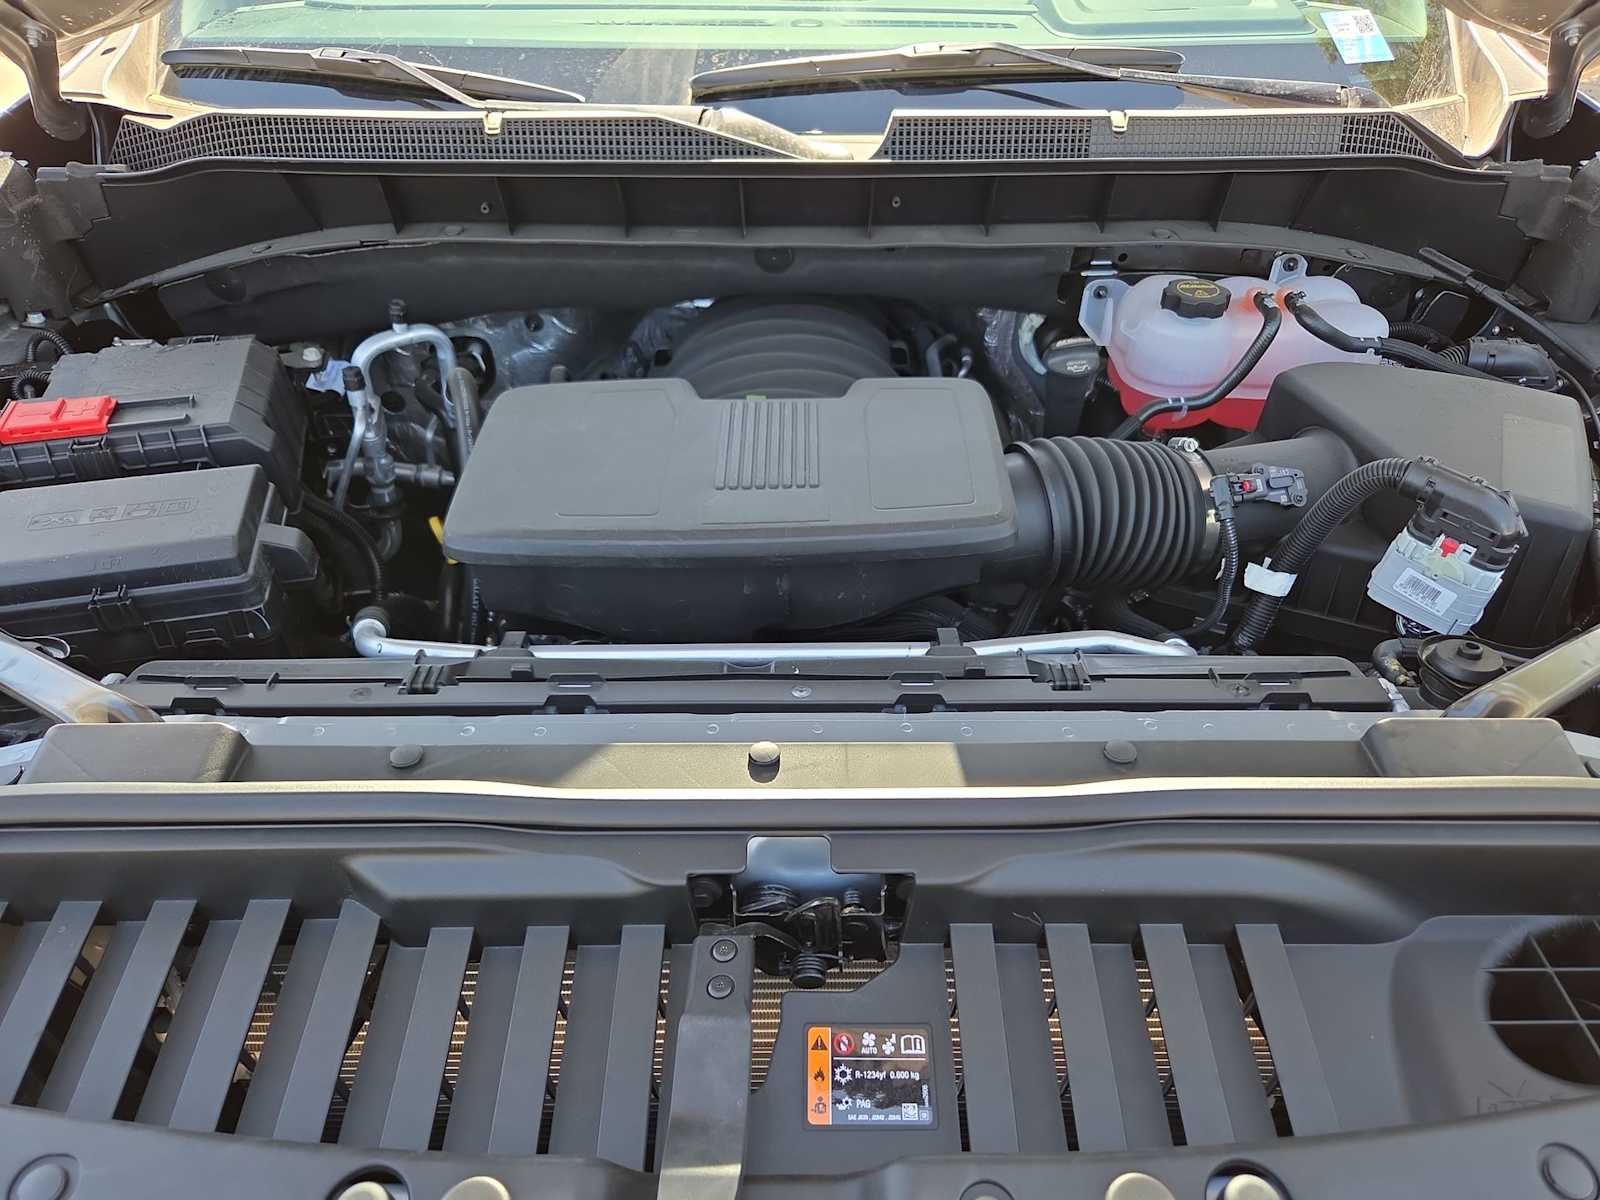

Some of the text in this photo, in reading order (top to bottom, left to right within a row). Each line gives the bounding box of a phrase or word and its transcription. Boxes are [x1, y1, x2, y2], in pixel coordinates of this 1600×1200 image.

[861, 1047, 878, 1055] AUTO
[855, 1071, 887, 1081] R-1234yf
[910, 1071, 920, 1081] kg
[856, 1100, 871, 1109] PAG
